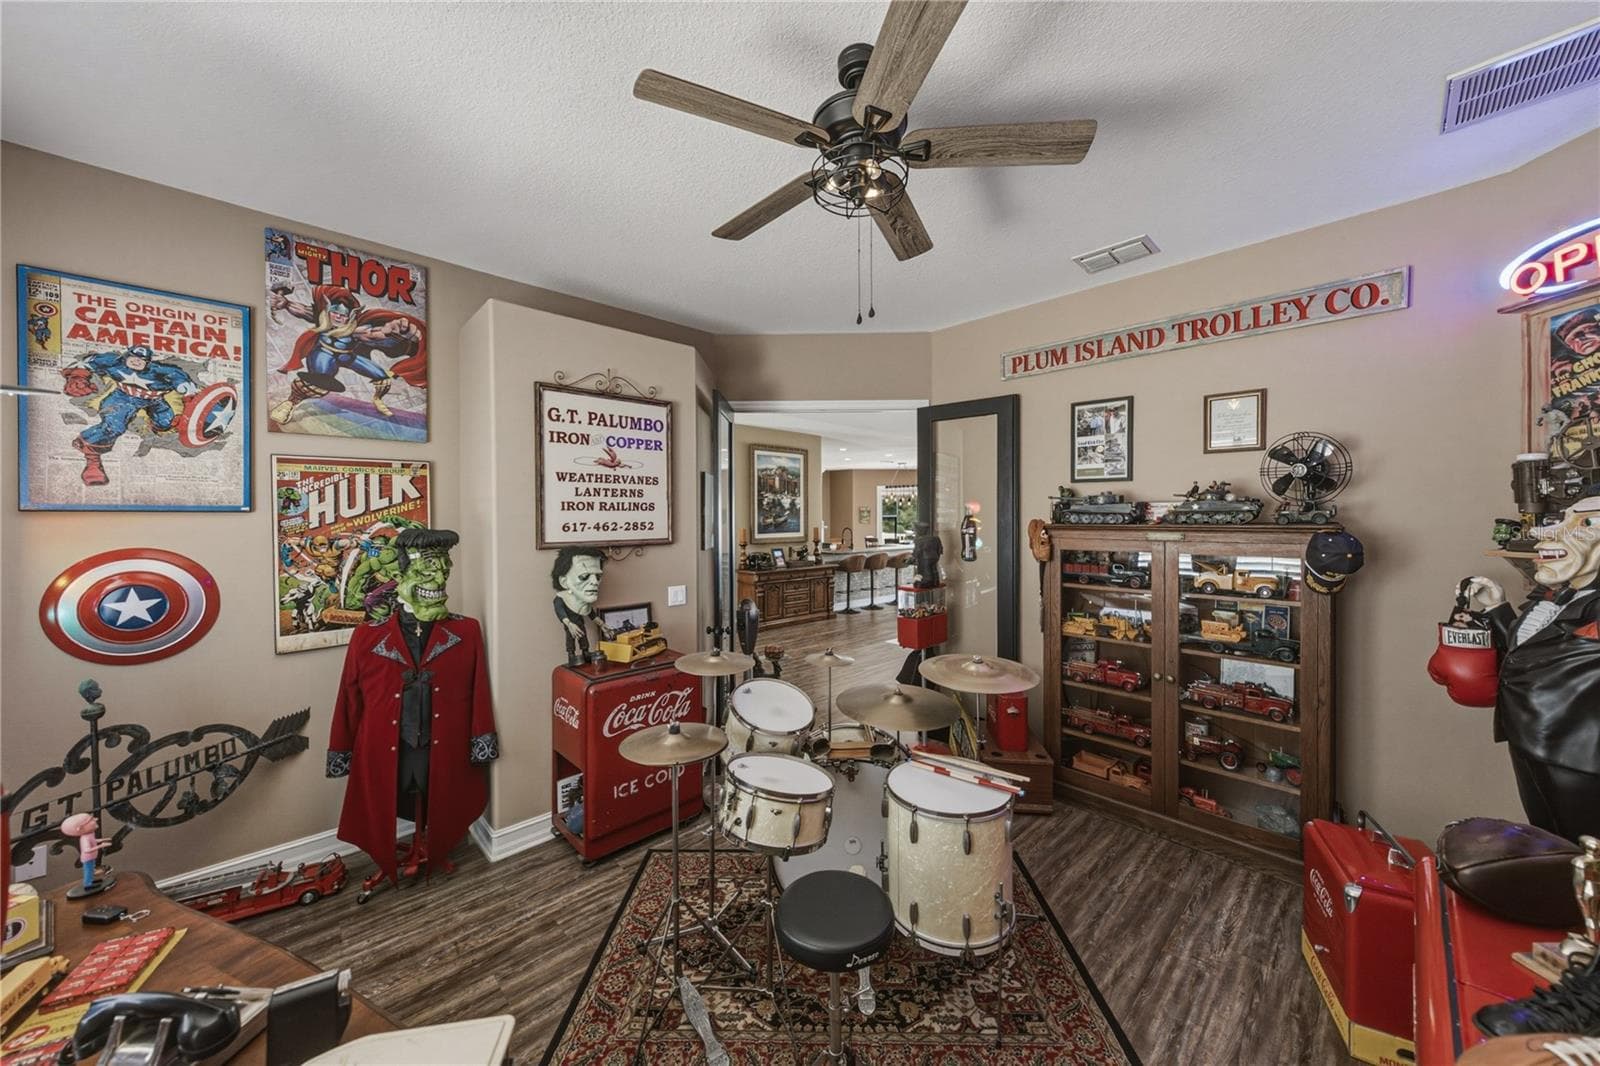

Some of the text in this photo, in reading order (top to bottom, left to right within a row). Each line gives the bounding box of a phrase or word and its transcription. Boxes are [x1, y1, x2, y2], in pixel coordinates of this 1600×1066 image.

[295, 241, 417, 306] THOR
[1511, 233, 1600, 295] OP
[45, 291, 59, 299] 109
[73, 291, 229, 326] THE ORIGIN OF
[75, 306, 228, 343] CAPTAIN
[1011, 281, 1390, 374] PLUM ISLAND TROLLEY CO.
[66, 322, 242, 361] AMERICA!
[547, 407, 664, 433] G.T. PALUMBO
[549, 431, 591, 445] IRON
[606, 436, 664, 451] COPPER
[304, 464, 338, 472] MARVEL
[378, 467, 406, 475] GROUP
[555, 472, 660, 486] WEATHERVANES
[296, 476, 315, 489] THE
[299, 472, 351, 494] INCREDIBLE
[575, 487, 644, 498] LANTERNS
[309, 461, 422, 529] HULK
[560, 501, 656, 512] IRON RAILINGS
[352, 500, 422, 527] WOLVERINE!
[562, 521, 655, 533] 617-462-2852
[1447, 629, 1488, 646] EVERLAST
[630, 690, 656, 702] DRINK
[554, 698, 580, 729] Coca-Cola
[603, 687, 694, 737] Coca-Cola
[106, 737, 237, 802] PALUMBO
[614, 779, 638, 799] ICE
